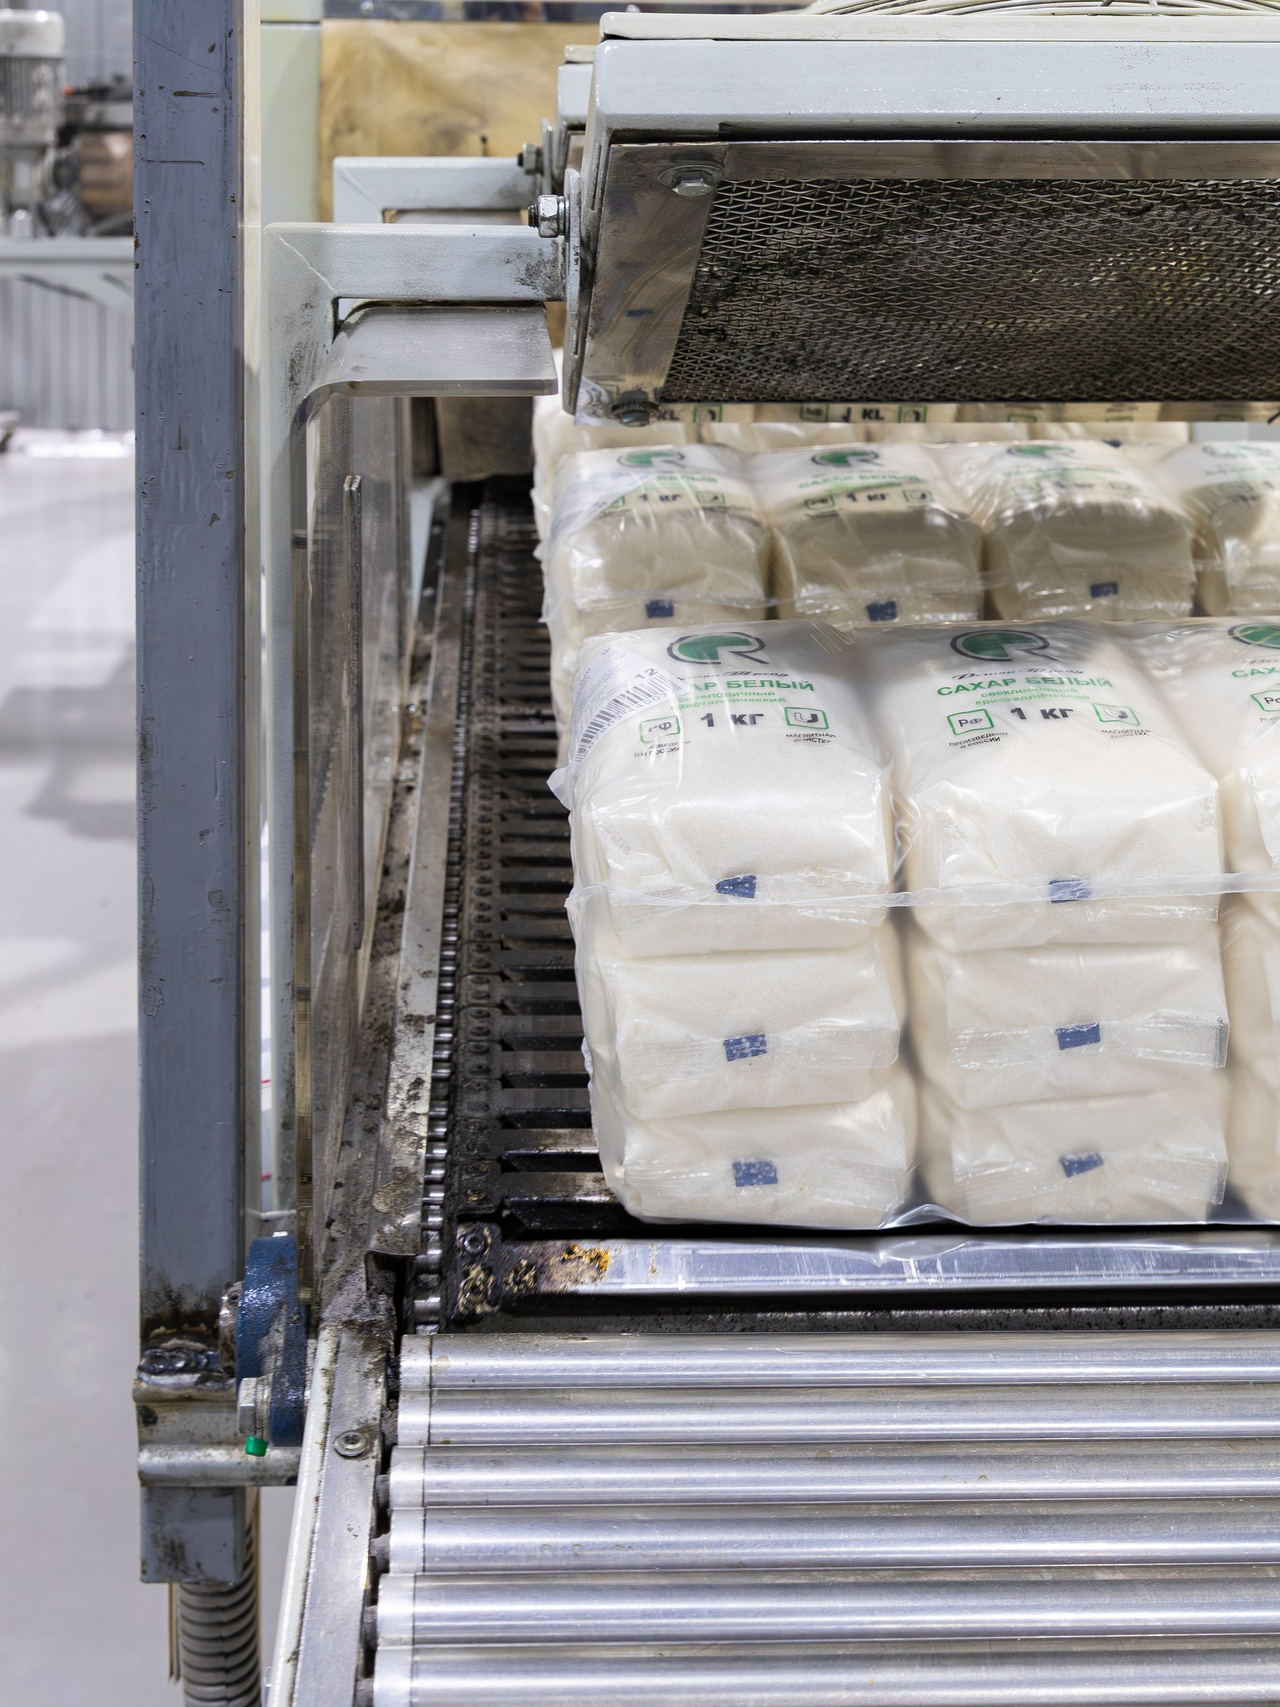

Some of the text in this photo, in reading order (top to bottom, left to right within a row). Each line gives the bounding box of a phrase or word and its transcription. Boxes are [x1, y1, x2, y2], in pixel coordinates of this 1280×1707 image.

[726, 679, 815, 692] БЕЛЫЙ
[936, 676, 1114, 696] САХАР БЕЛЫЙ
[700, 712, 715, 727] 1
[1010, 707, 1028, 720] 1
[958, 717, 983, 728] РФ
